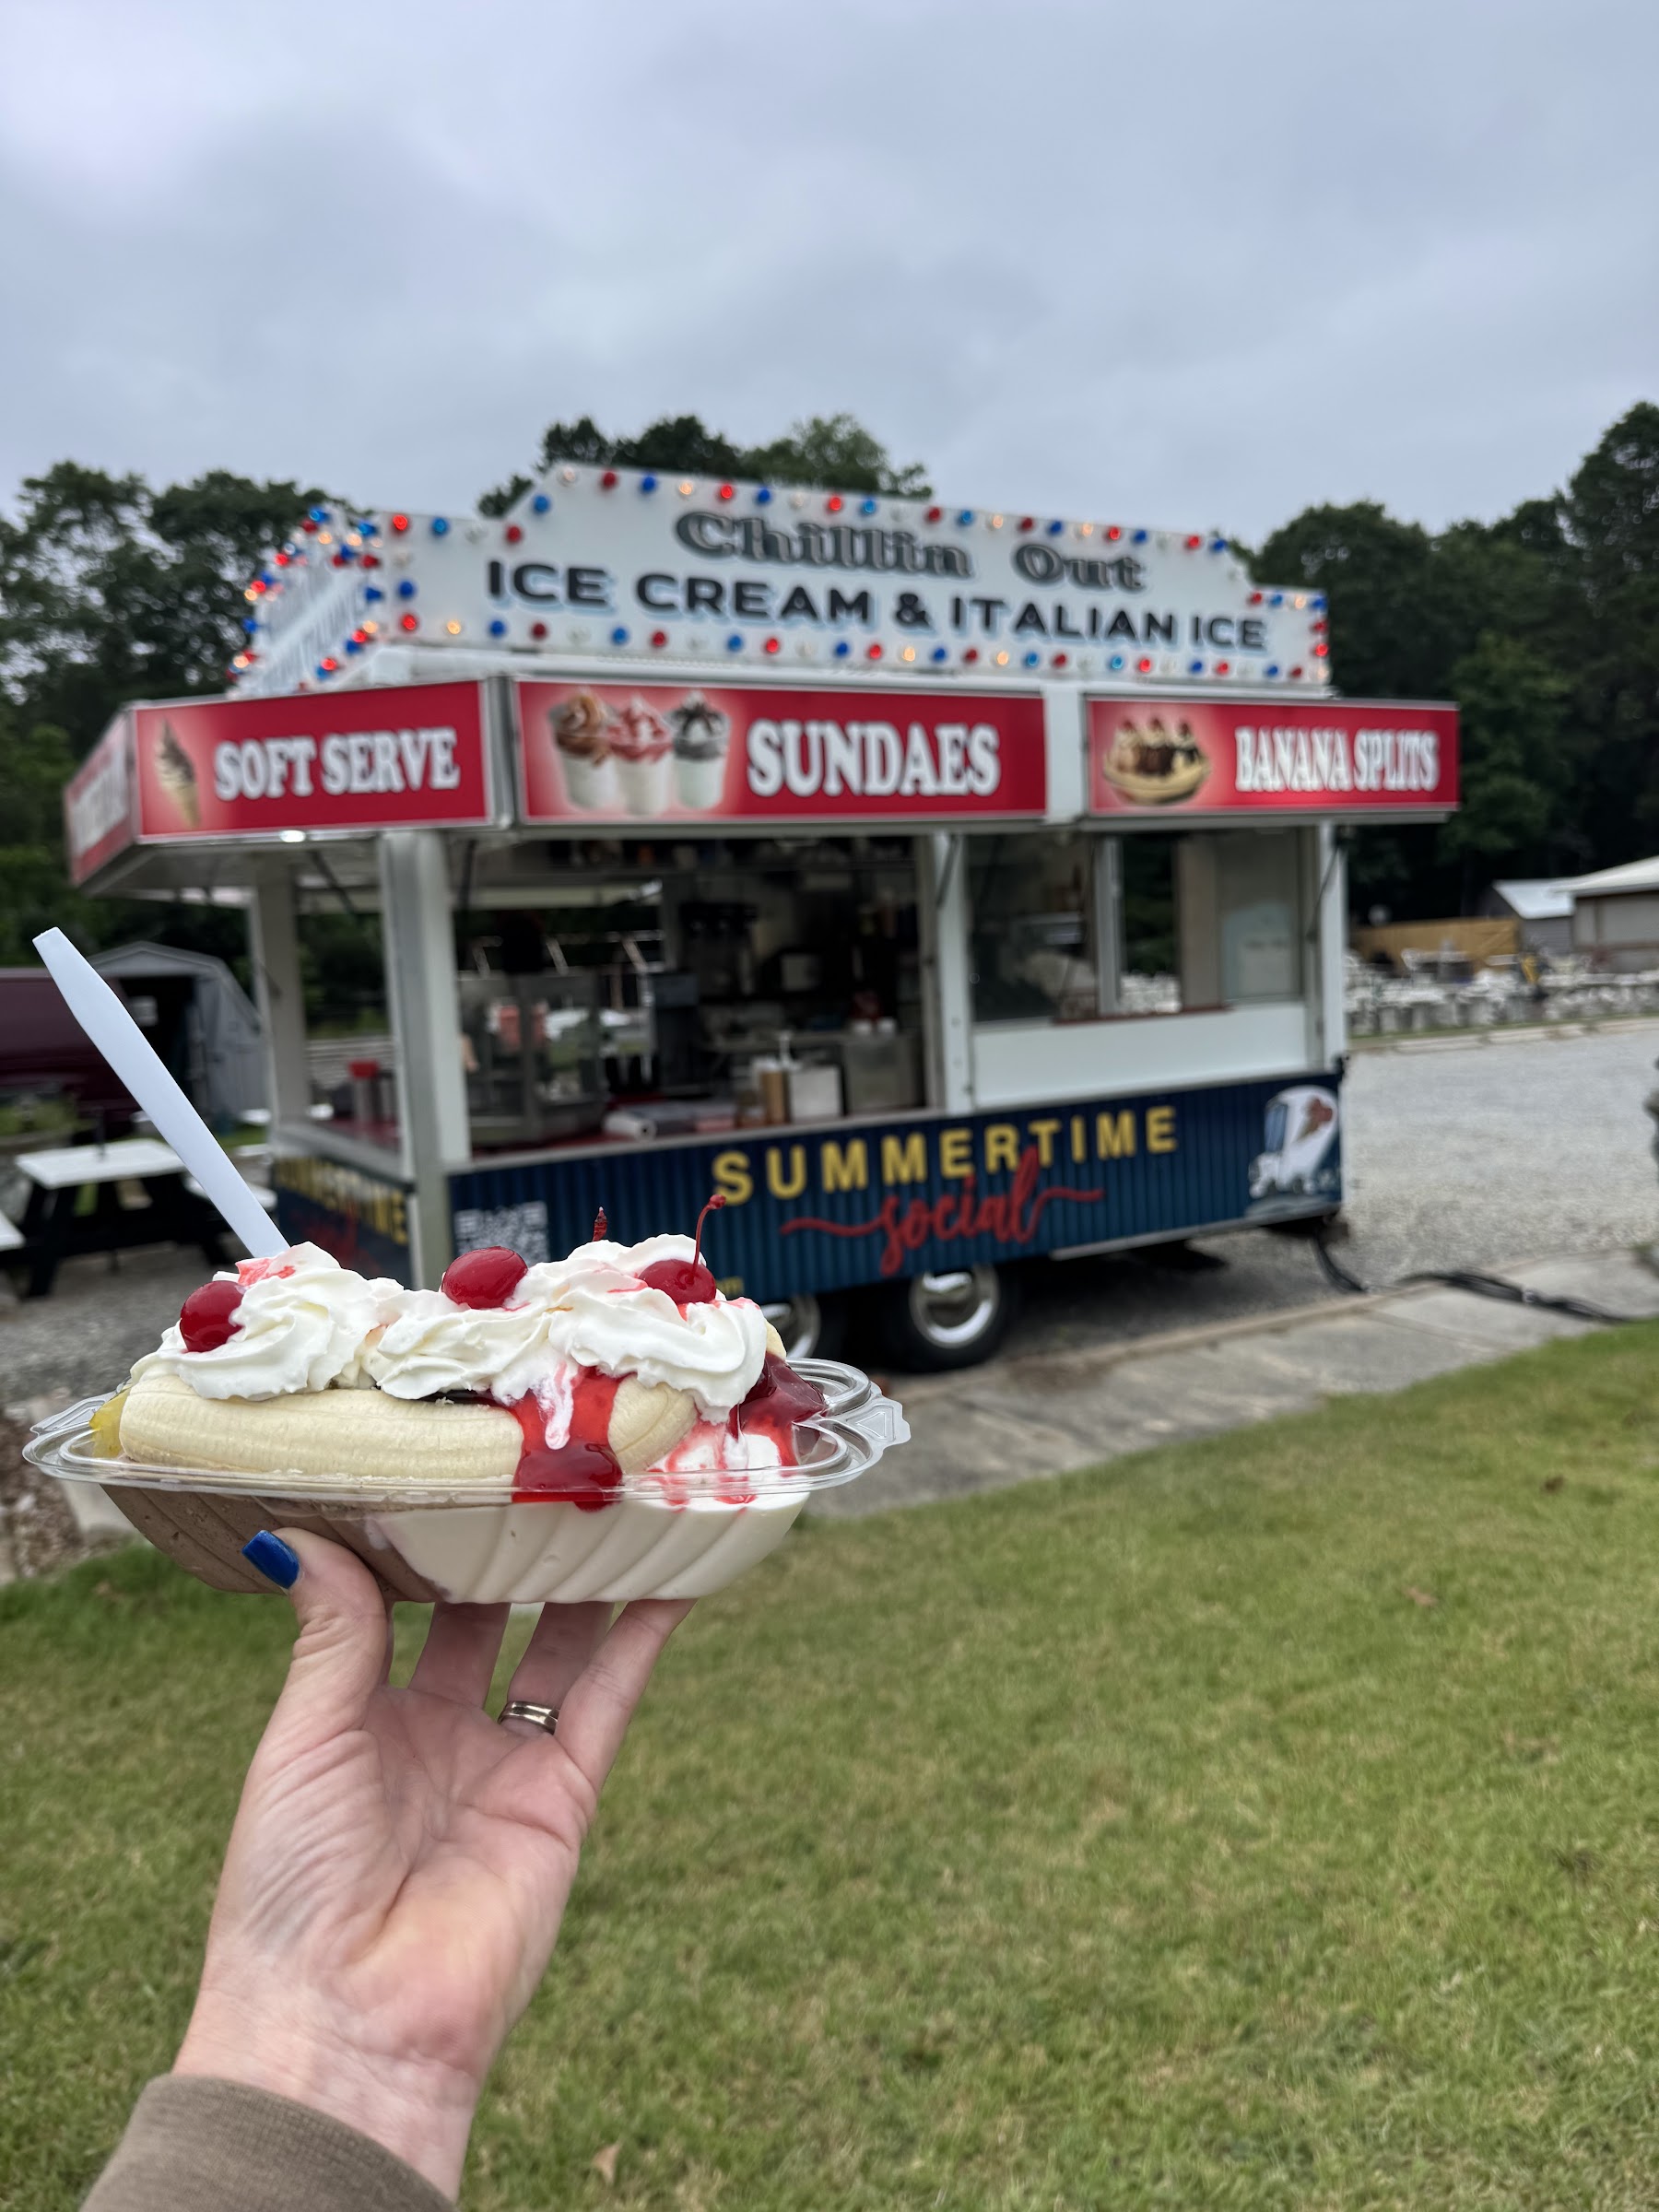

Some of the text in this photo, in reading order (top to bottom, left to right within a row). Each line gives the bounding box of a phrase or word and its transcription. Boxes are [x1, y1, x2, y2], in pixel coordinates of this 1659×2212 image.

[676, 511, 1147, 592] Chillin Out
[488, 560, 1266, 649] ICE CREAM & ITALIAN ICE
[213, 726, 461, 801] SOFT SERVE
[746, 719, 1002, 796] SUNDAES
[1233, 726, 1440, 793] BANANA SPLITS
[712, 1107, 1177, 1205] SUMMERTIME
[779, 1145, 1104, 1276] social
